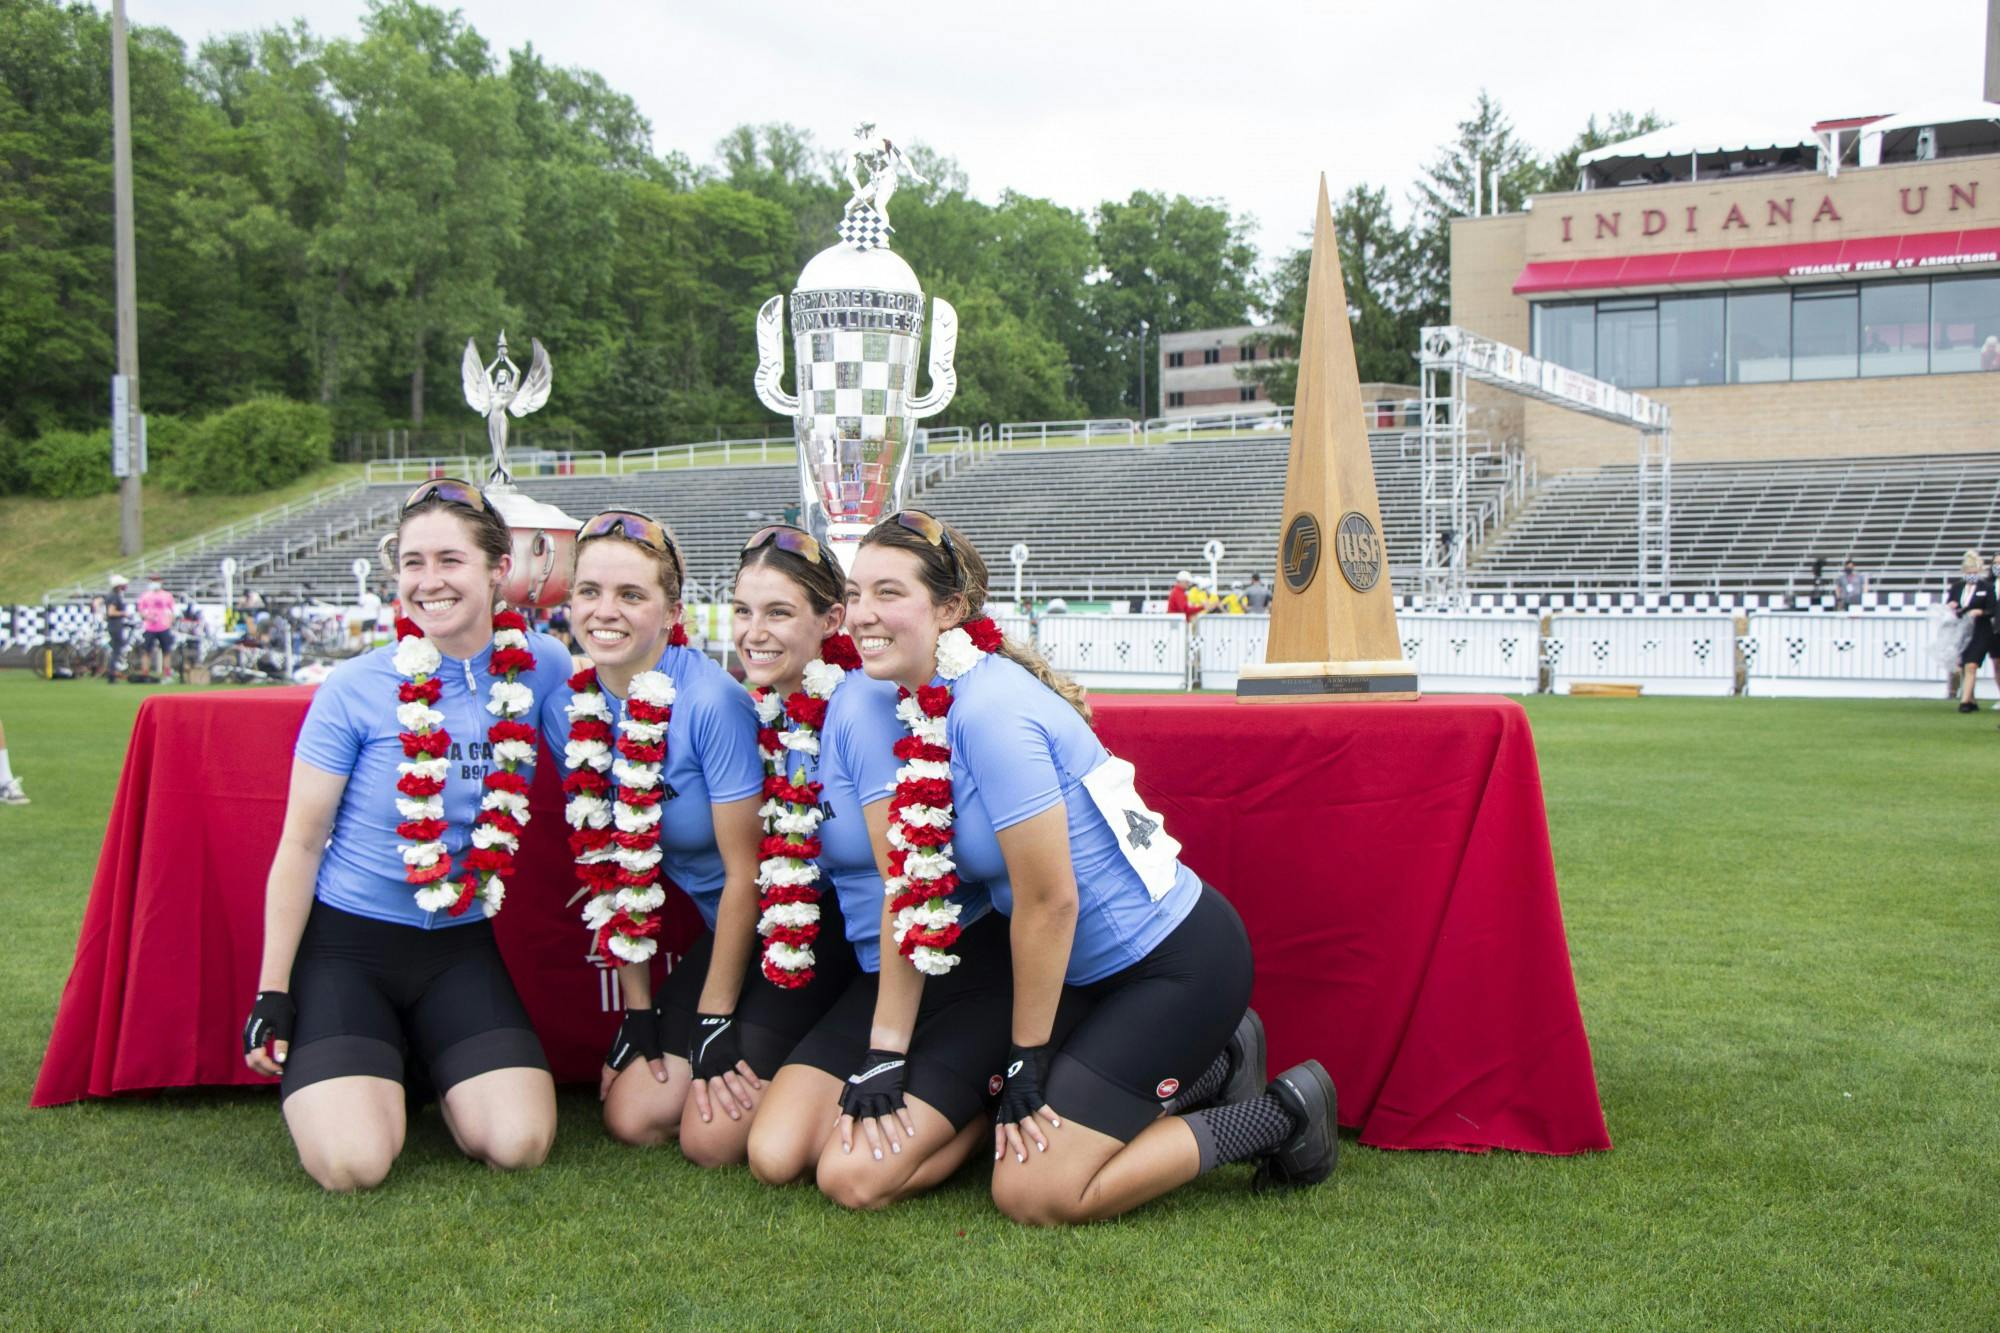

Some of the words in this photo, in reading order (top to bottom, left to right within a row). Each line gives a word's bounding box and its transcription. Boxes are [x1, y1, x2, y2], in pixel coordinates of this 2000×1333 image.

[1561, 195, 1842, 243] INDIANA
[1855, 259, 1891, 271] FIELD
[1896, 257, 1915, 269] AT
[1918, 251, 1998, 268] ARMSTRONG
[846, 311, 901, 330] LITTLE
[904, 313, 923, 334] 500
[1209, 543, 1217, 558] 4
[468, 742, 495, 761] GA
[1121, 808, 1159, 850] 4
